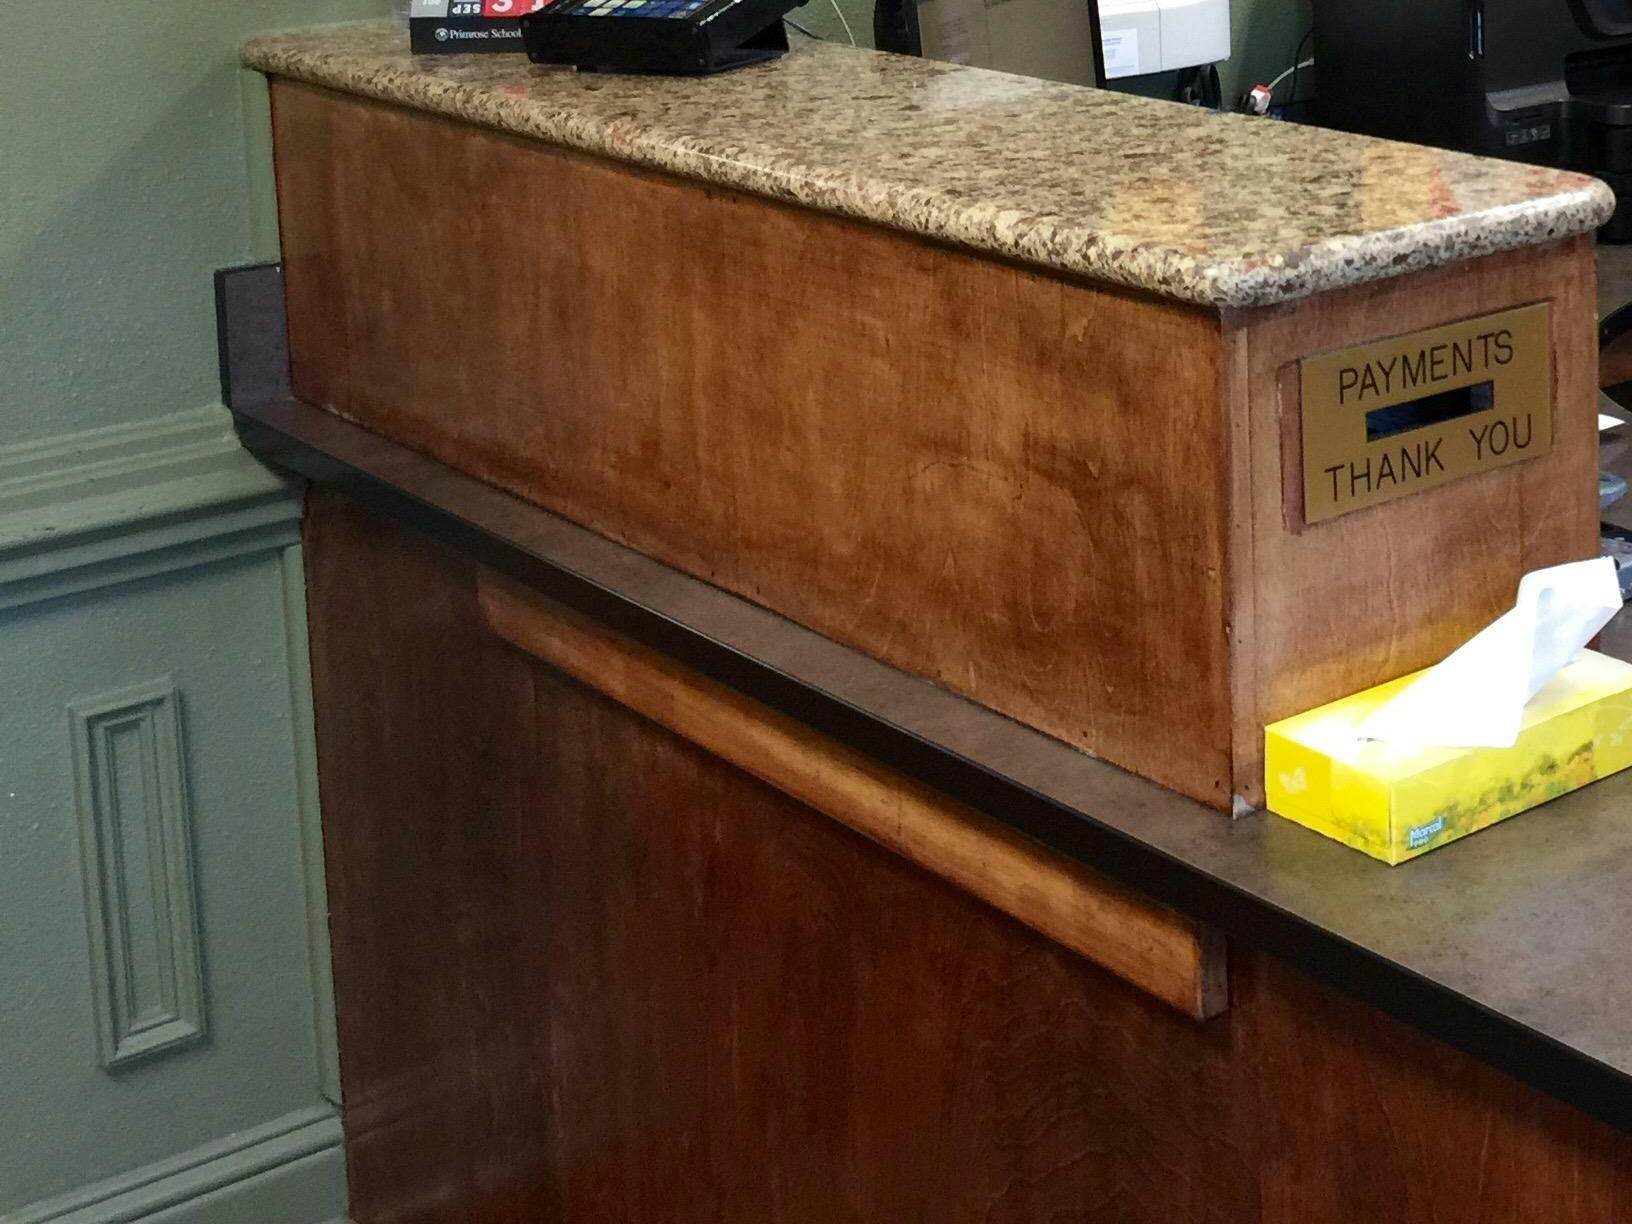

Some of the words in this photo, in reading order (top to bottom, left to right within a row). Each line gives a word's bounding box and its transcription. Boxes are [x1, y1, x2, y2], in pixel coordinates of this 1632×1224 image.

[452, 4, 481, 14] SEP
[450, 29, 489, 39] Primrose
[1338, 329, 1514, 405] PAYMENTS
[1324, 437, 1445, 502] THANK
[1469, 413, 1532, 461] YOU
